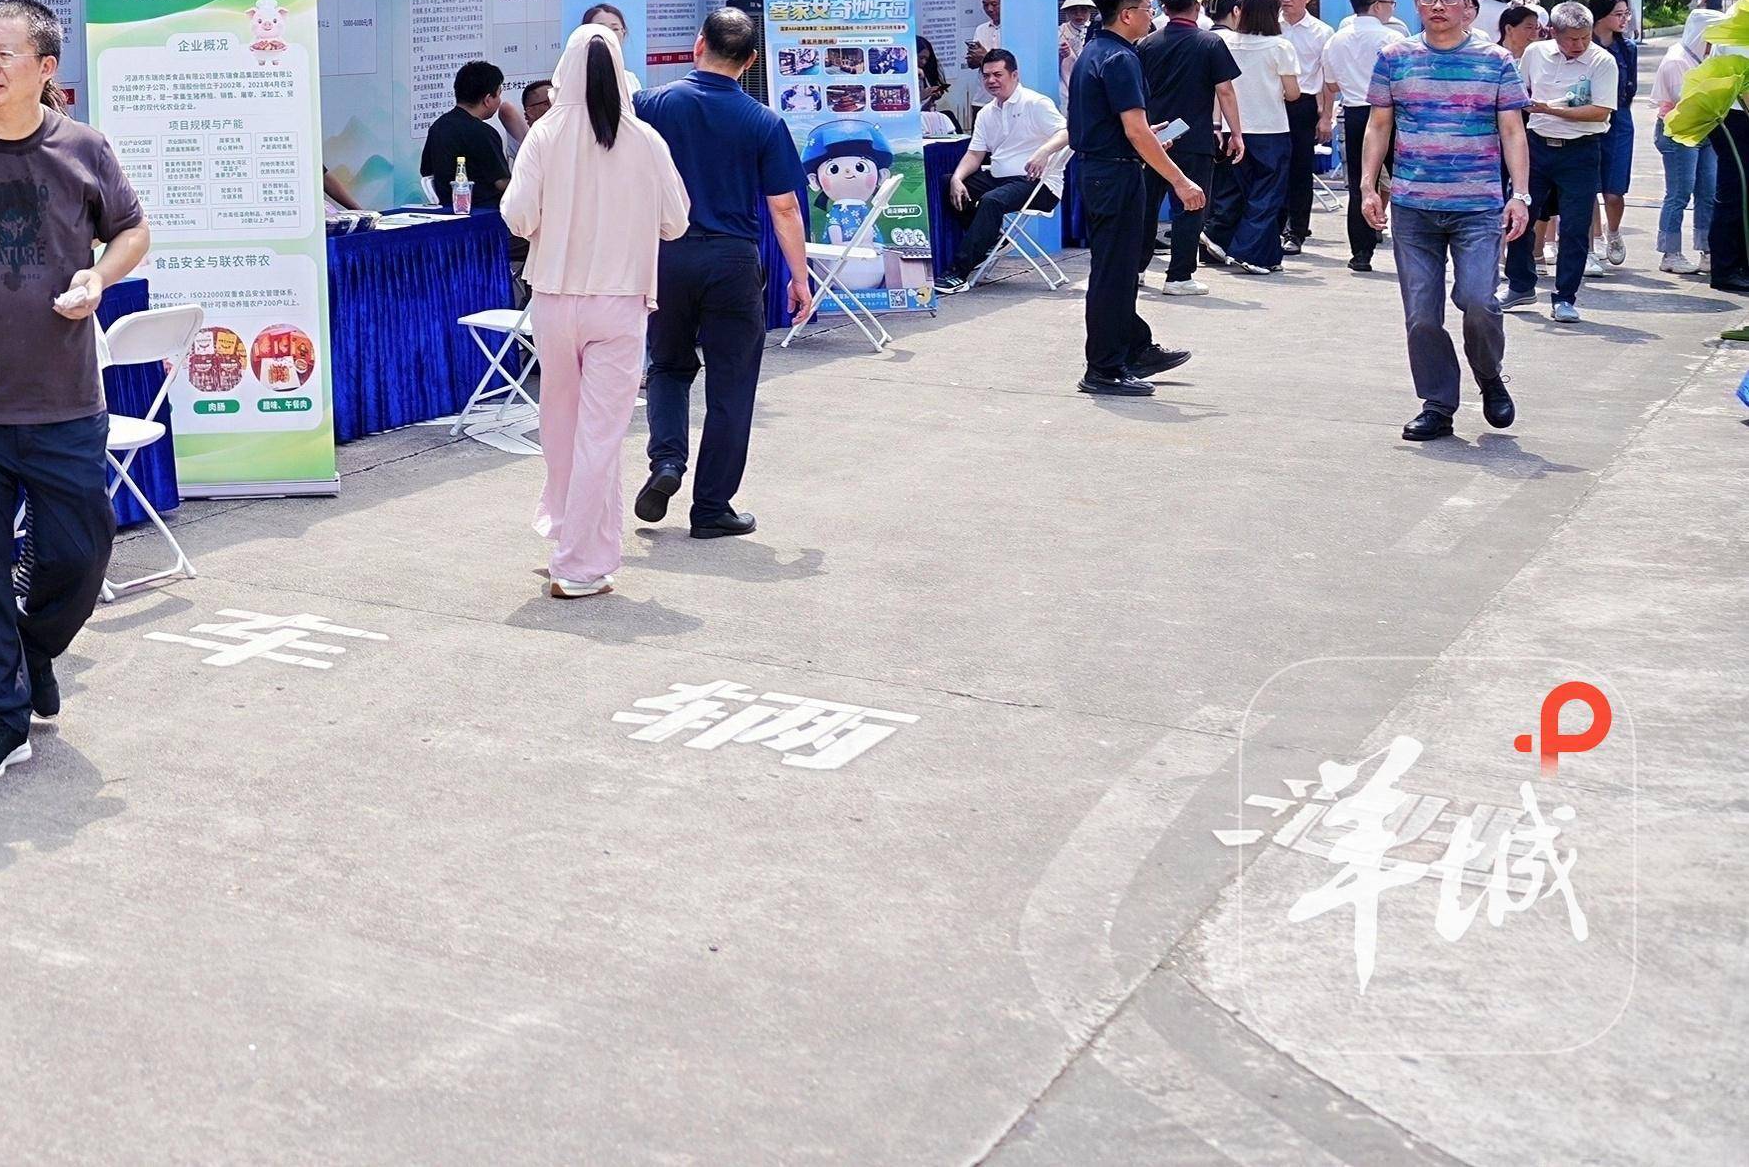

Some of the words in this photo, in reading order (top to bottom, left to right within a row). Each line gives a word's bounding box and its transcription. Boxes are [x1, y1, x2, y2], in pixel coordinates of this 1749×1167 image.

[178, 38, 229, 52] 企业概况
[169, 119, 243, 131] 项目规模与产能
[156, 255, 270, 270] 食品安全与联农带农
